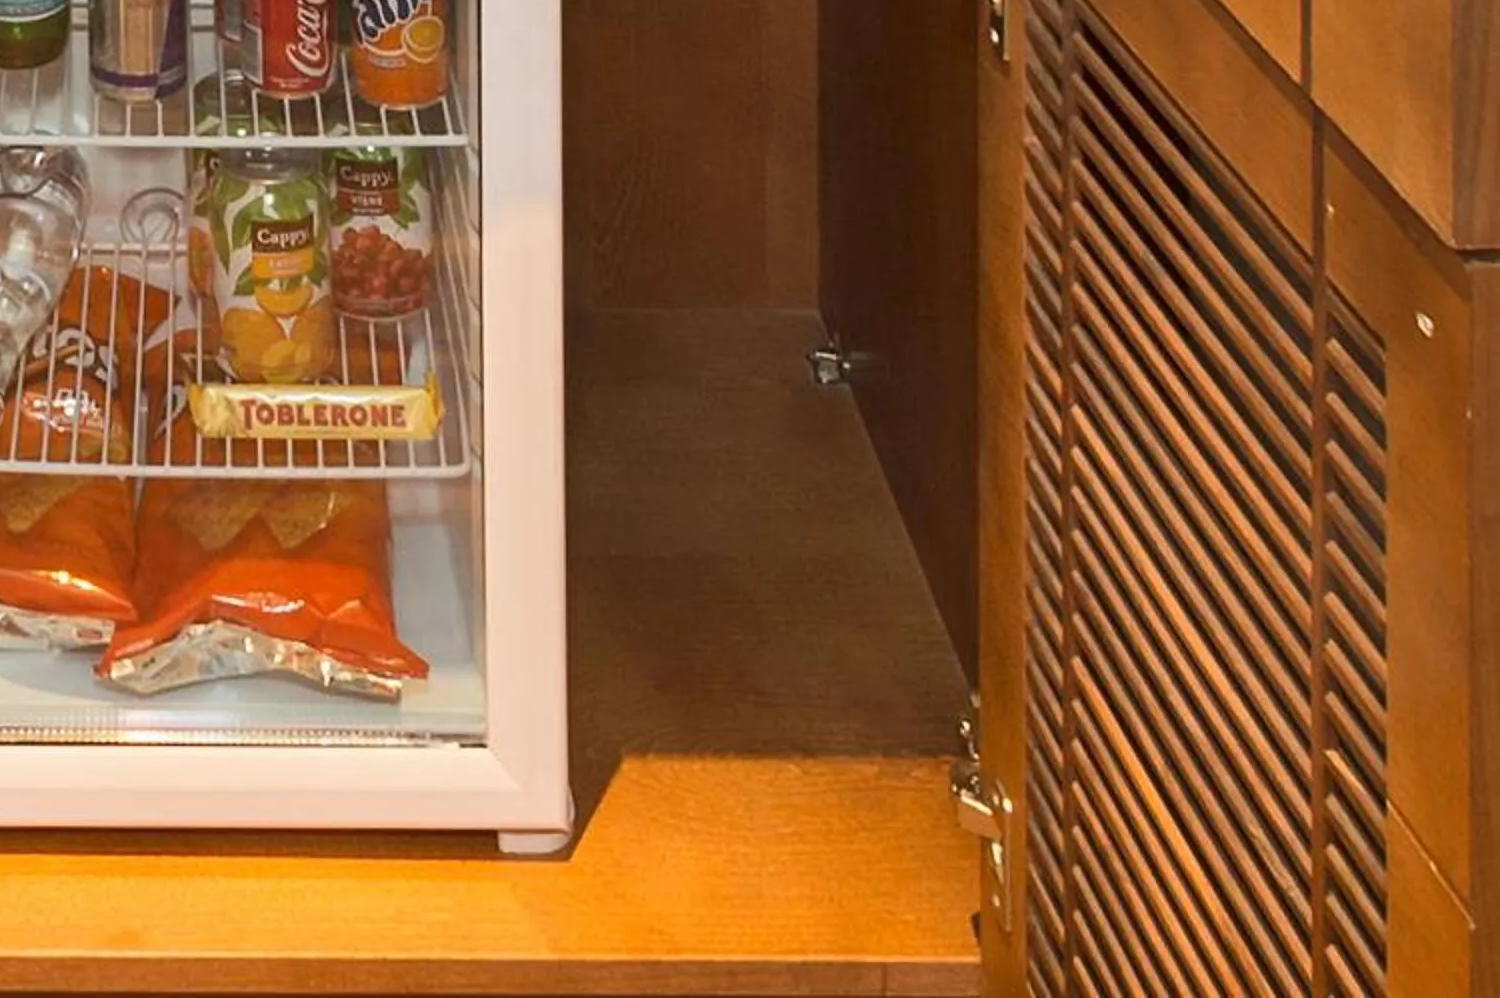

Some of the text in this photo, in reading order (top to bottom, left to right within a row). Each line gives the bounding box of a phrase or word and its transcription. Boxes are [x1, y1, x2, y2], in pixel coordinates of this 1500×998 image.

[339, 165, 393, 187] Cappy
[256, 227, 308, 249] Cappy
[239, 399, 406, 430] TOBLERONE
